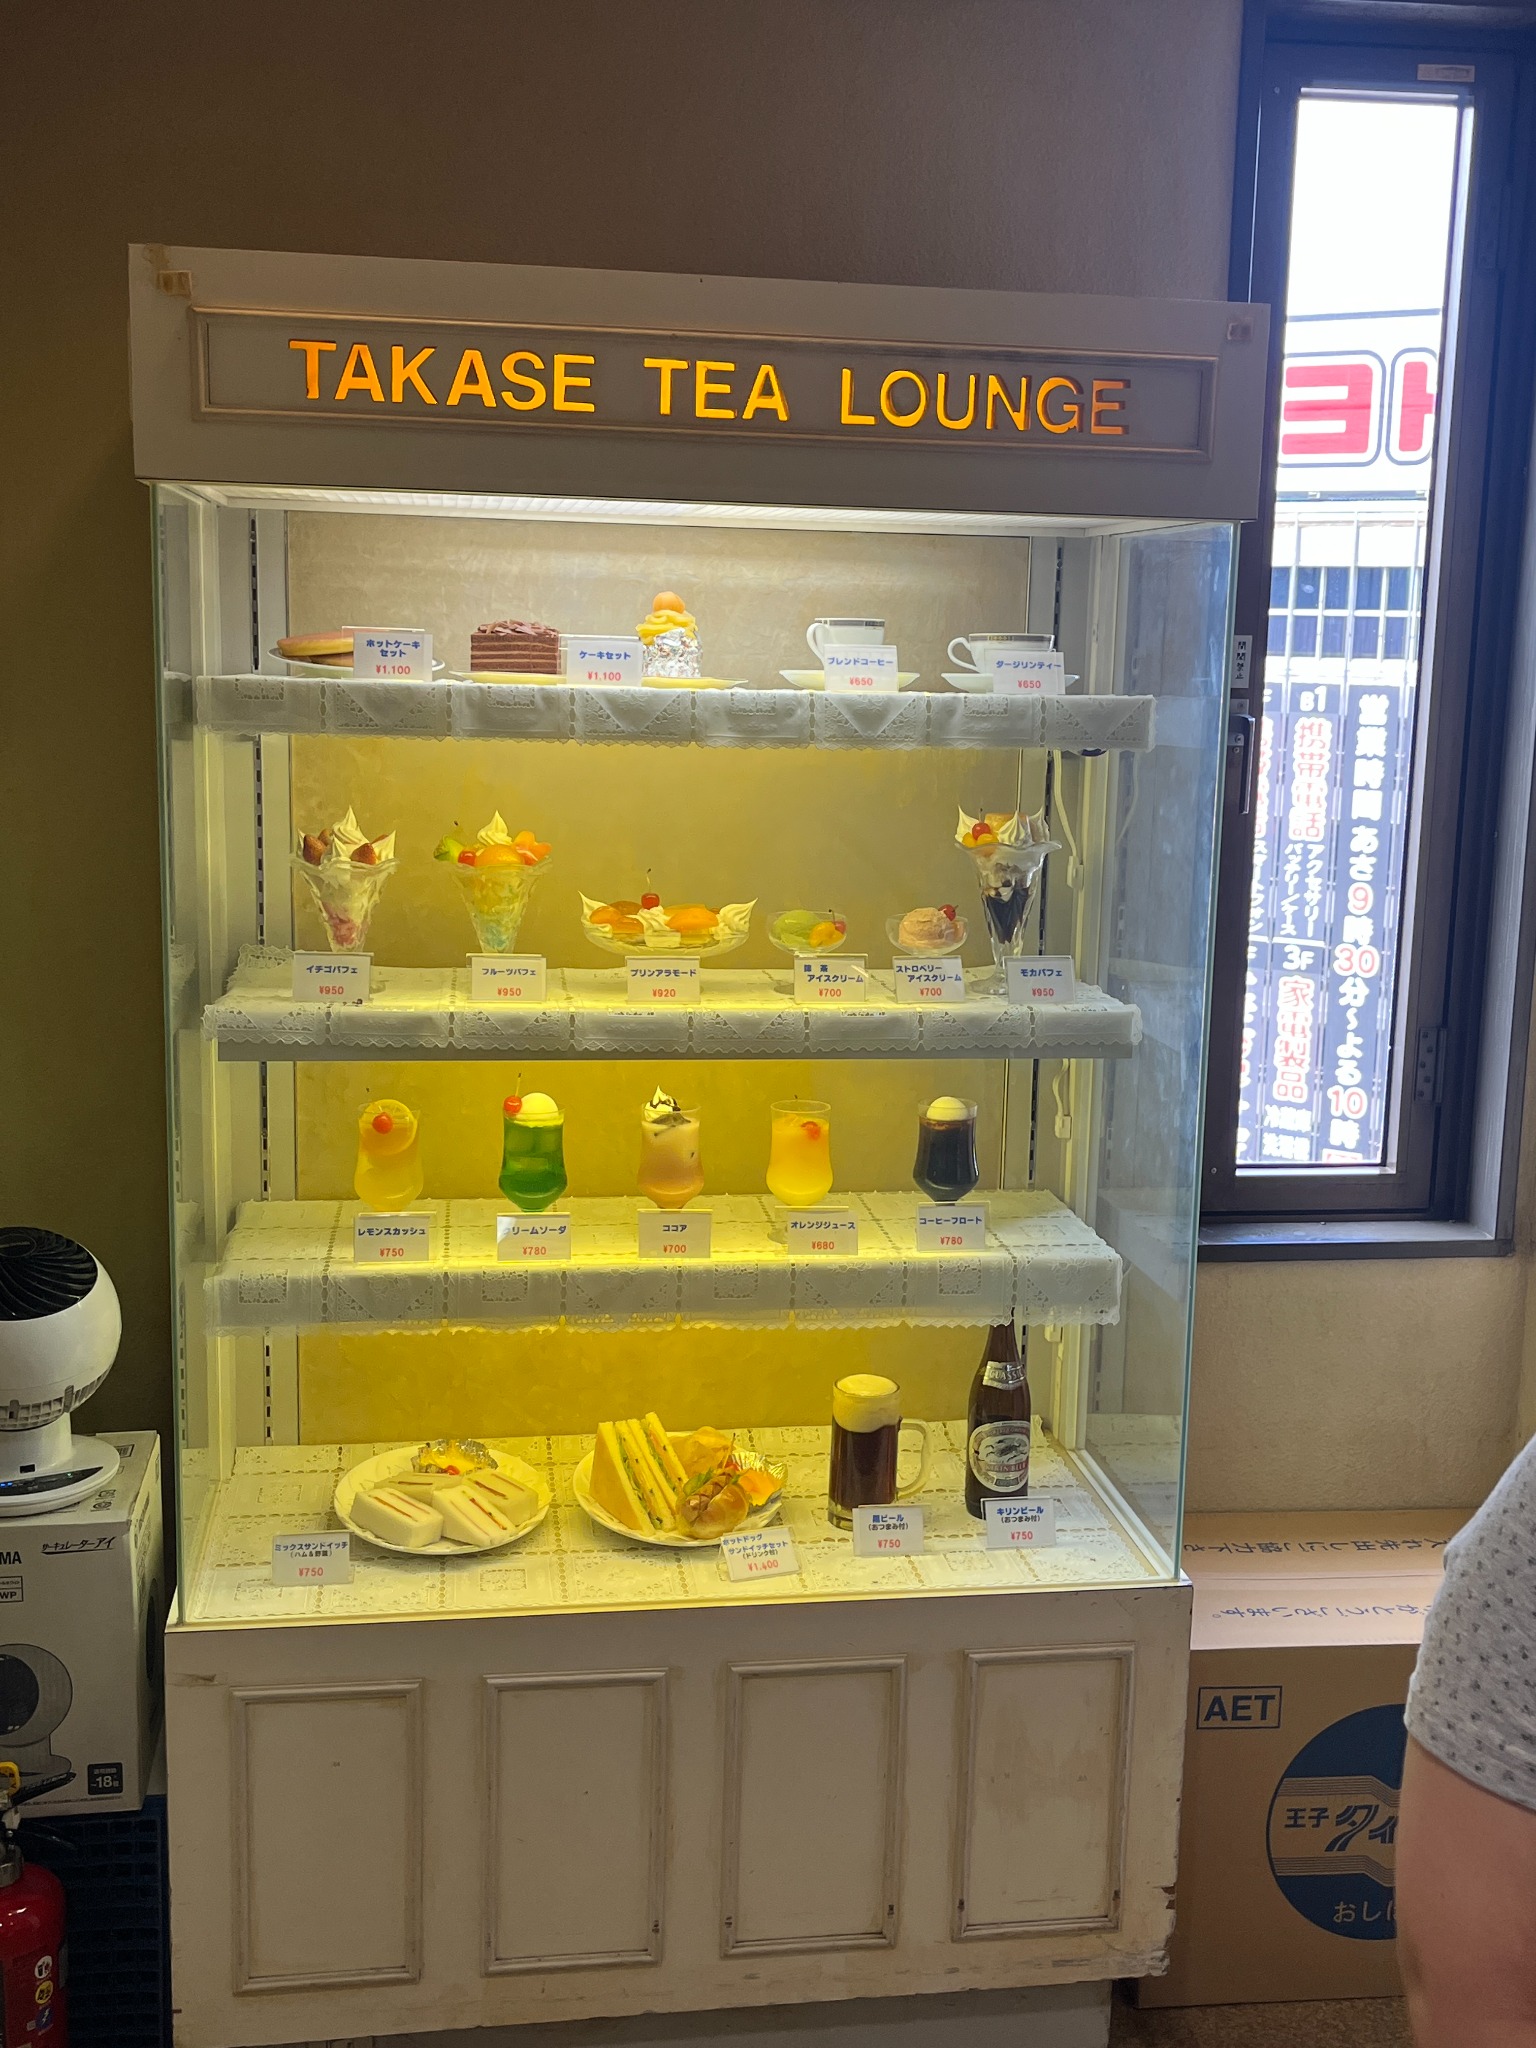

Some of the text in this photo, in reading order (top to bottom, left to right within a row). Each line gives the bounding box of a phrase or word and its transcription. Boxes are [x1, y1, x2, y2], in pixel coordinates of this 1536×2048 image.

[288, 339, 1131, 435] TAKASE TEA LOUNGE
[366, 639, 420, 649] ホットケーキ
[380, 648, 406, 658] セット
[579, 651, 631, 660] ケーキセット
[827, 657, 893, 666] ブレンドコーヒー
[996, 660, 1061, 670] ダージリンティー
[849, 677, 873, 686] ¥650
[1017, 680, 1041, 689] ¥650
[1303, 843, 1325, 937] アクセサリー
[1283, 945, 1315, 970] 3F
[306, 965, 358, 974] イチゴパフェ
[481, 967, 536, 977] フルーツパフェ
[630, 968, 697, 978] プリンアラモード
[896, 964, 942, 973] ストロベリー
[1020, 968, 1062, 977] モカパフェ
[807, 974, 863, 983] アイスクリーム
[907, 974, 962, 983] アイスクリーム
[319, 985, 344, 995] ¥950
[497, 987, 522, 997] ¥950
[652, 988, 676, 998] ¥920
[818, 988, 842, 998] ¥700
[920, 987, 942, 997] ¥700
[1032, 988, 1054, 997] ¥950
[790, 1221, 856, 1230] オレンジジュース
[919, 1216, 982, 1226] コーヒーフロート
[358, 1226, 426, 1236] レモンスカッシュ
[663, 1224, 688, 1233] ココア
[811, 1241, 835, 1250] ¥680
[940, 1236, 963, 1246] ¥780
[380, 1247, 404, 1257] ¥750
[522, 1246, 547, 1256] ¥780
[663, 1244, 687, 1254] ¥700
[997, 1506, 1044, 1516] キリンビール
[872, 1513, 905, 1524] 黒ビール
[1010, 1531, 1034, 1541] ¥750
[275, 1541, 348, 1551] ミックスサンドイッチ
[877, 1539, 901, 1549] ¥750
[298, 1567, 324, 1577] ¥750
[1212, 1604, 1432, 1619] がとうございます。
[1203, 1694, 1276, 1723] AET
